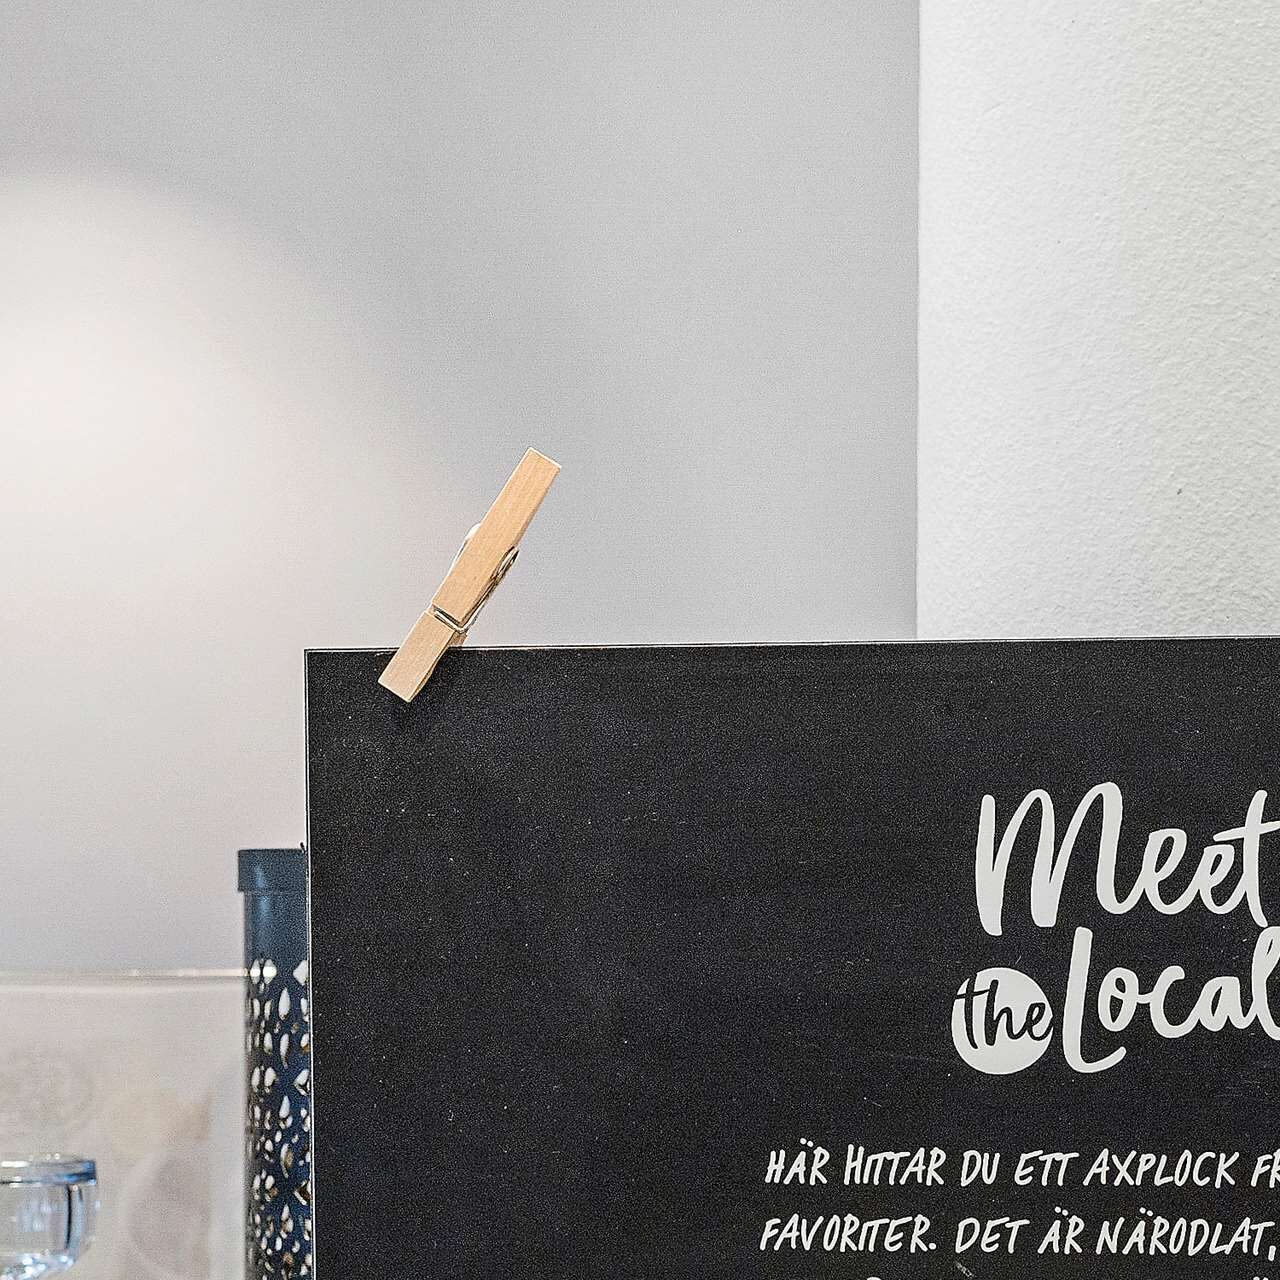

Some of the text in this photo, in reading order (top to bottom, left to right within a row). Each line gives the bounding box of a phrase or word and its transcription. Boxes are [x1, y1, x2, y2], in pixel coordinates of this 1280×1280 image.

[956, 977, 1052, 1043] the
[765, 1138, 829, 1185] HÄR
[844, 1144, 946, 1186] HITTAR
[961, 1150, 1000, 1186] DU
[1015, 1150, 1079, 1186] ETT
[1083, 1149, 1239, 1188] AXPLOCK
[760, 1214, 936, 1253] FAVORITER.
[956, 1217, 1030, 1253] DET
[1038, 1207, 1084, 1254] ÄR
[1096, 1208, 1276, 1261] NÄRODLAT,
